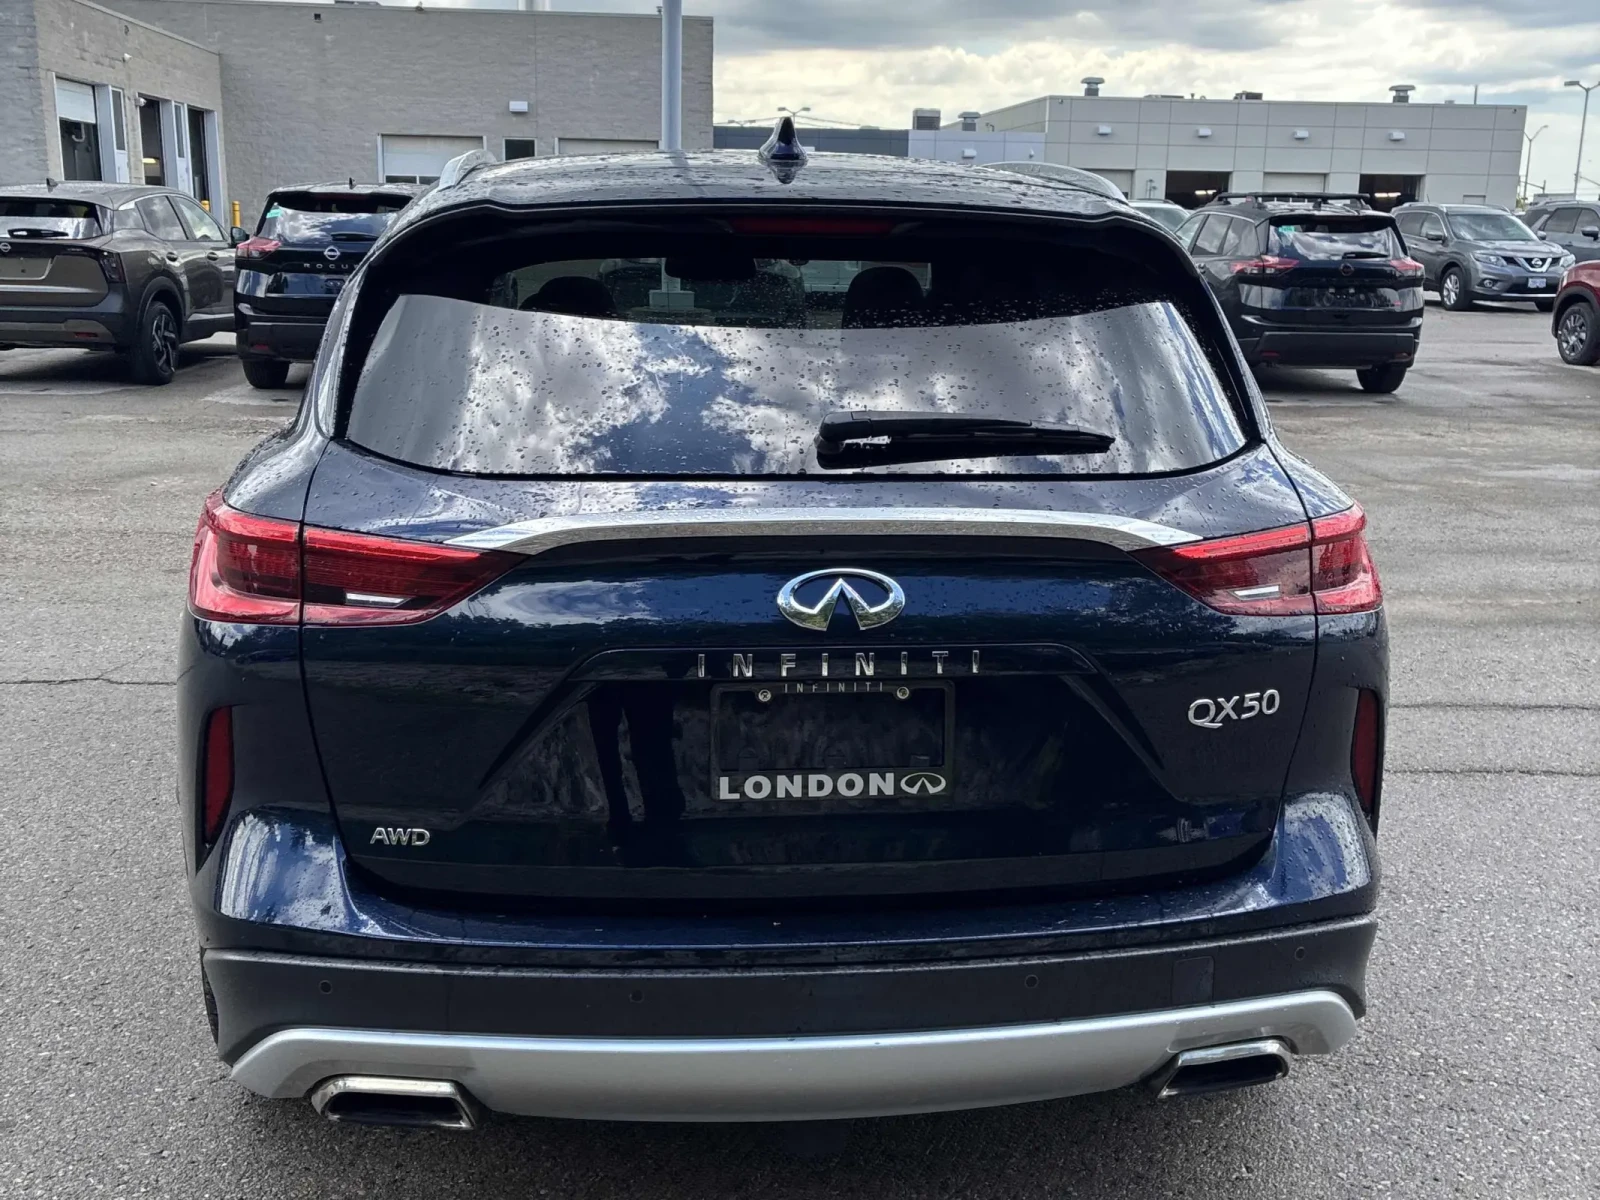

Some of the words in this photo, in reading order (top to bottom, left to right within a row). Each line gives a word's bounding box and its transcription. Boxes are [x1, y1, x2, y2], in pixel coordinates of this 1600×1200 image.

[697, 650, 980, 677] INFINITI
[784, 682, 884, 693] INFINITI
[1188, 689, 1280, 728] QX50
[719, 772, 895, 799] LONDON
[369, 827, 430, 845] AWD
